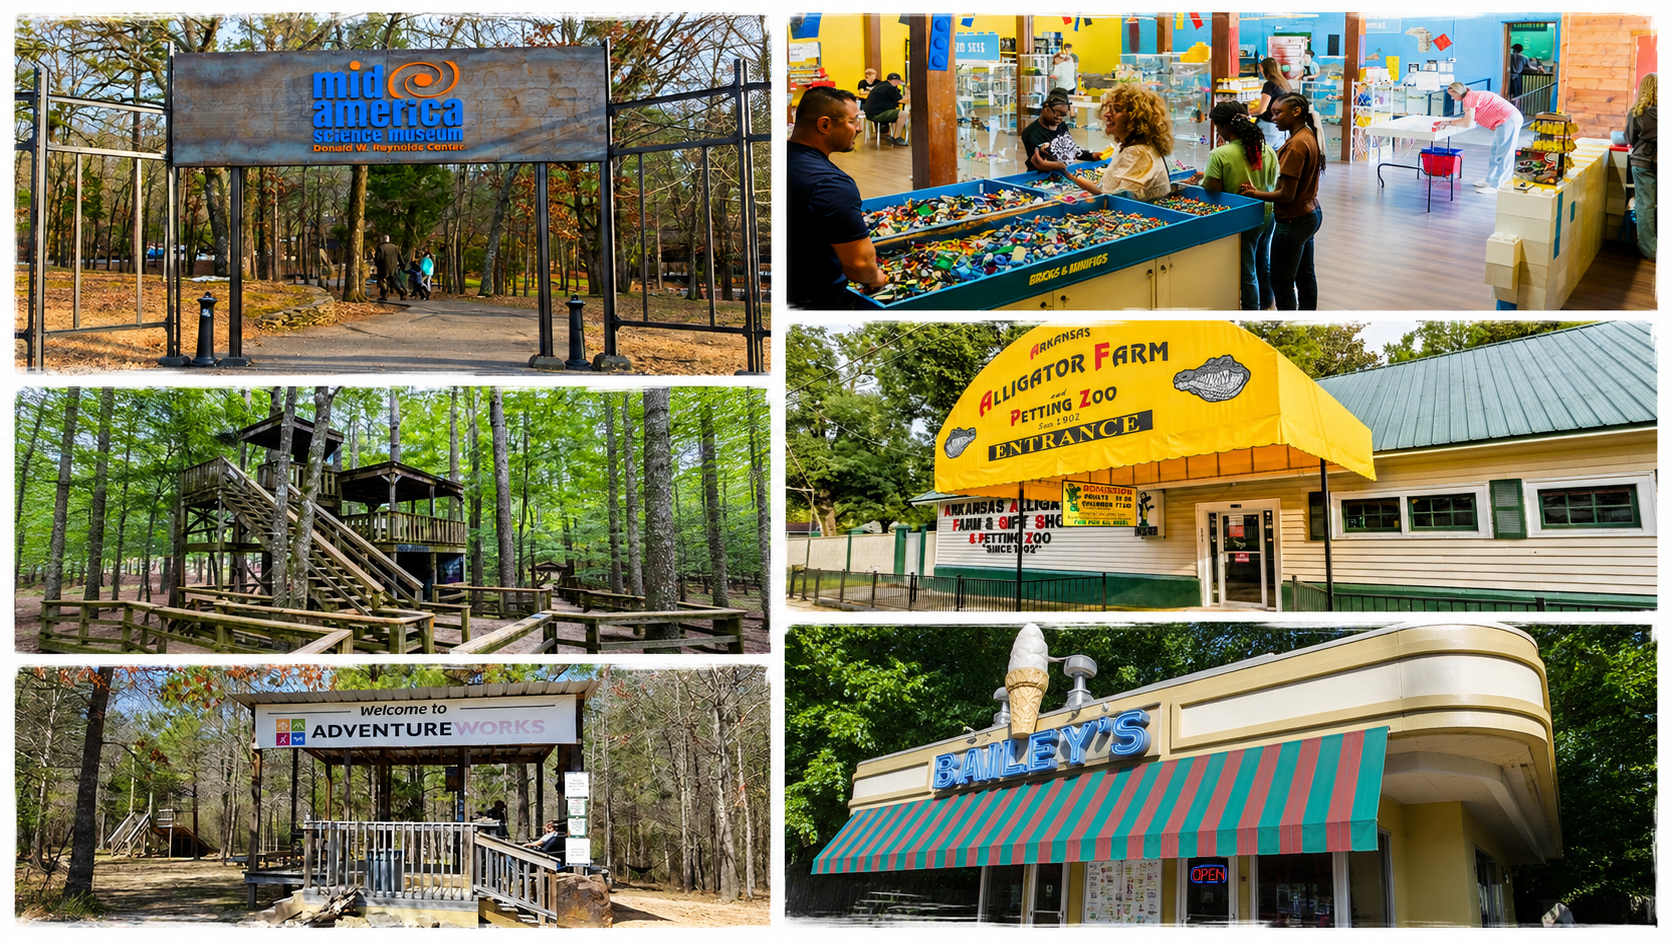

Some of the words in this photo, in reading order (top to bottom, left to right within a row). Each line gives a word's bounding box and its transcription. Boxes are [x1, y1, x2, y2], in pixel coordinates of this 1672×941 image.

[313, 61, 383, 99] mid
[313, 98, 463, 128] america
[313, 129, 382, 143] science
[388, 128, 463, 142] museum
[313, 144, 353, 152] Donald
[356, 144, 370, 152] W.
[373, 143, 424, 153] Reynolds
[427, 143, 464, 151] Center
[1029, 267, 1060, 286] BRICKS
[1061, 265, 1068, 276] &
[1068, 253, 1108, 274] MINIFIGS
[1030, 327, 1091, 360] ARKANSAS
[979, 354, 1086, 417] ALLIGATOR
[1094, 341, 1169, 371] FARM
[1050, 388, 1067, 399] and
[1010, 398, 1072, 426] PETTING
[1079, 386, 1117, 409] ZOO
[1056, 412, 1080, 426] 1902
[994, 414, 1141, 460] ENTRANCE
[944, 498, 1005, 517] ARKANSAS
[1025, 532, 1052, 544] ZOO
[360, 704, 427, 716] Welcome
[432, 703, 447, 714] to
[311, 719, 546, 739] ADVENTUREWORKS
[933, 709, 1150, 789] BAILEY'S
[1192, 867, 1225, 882] OPEN
